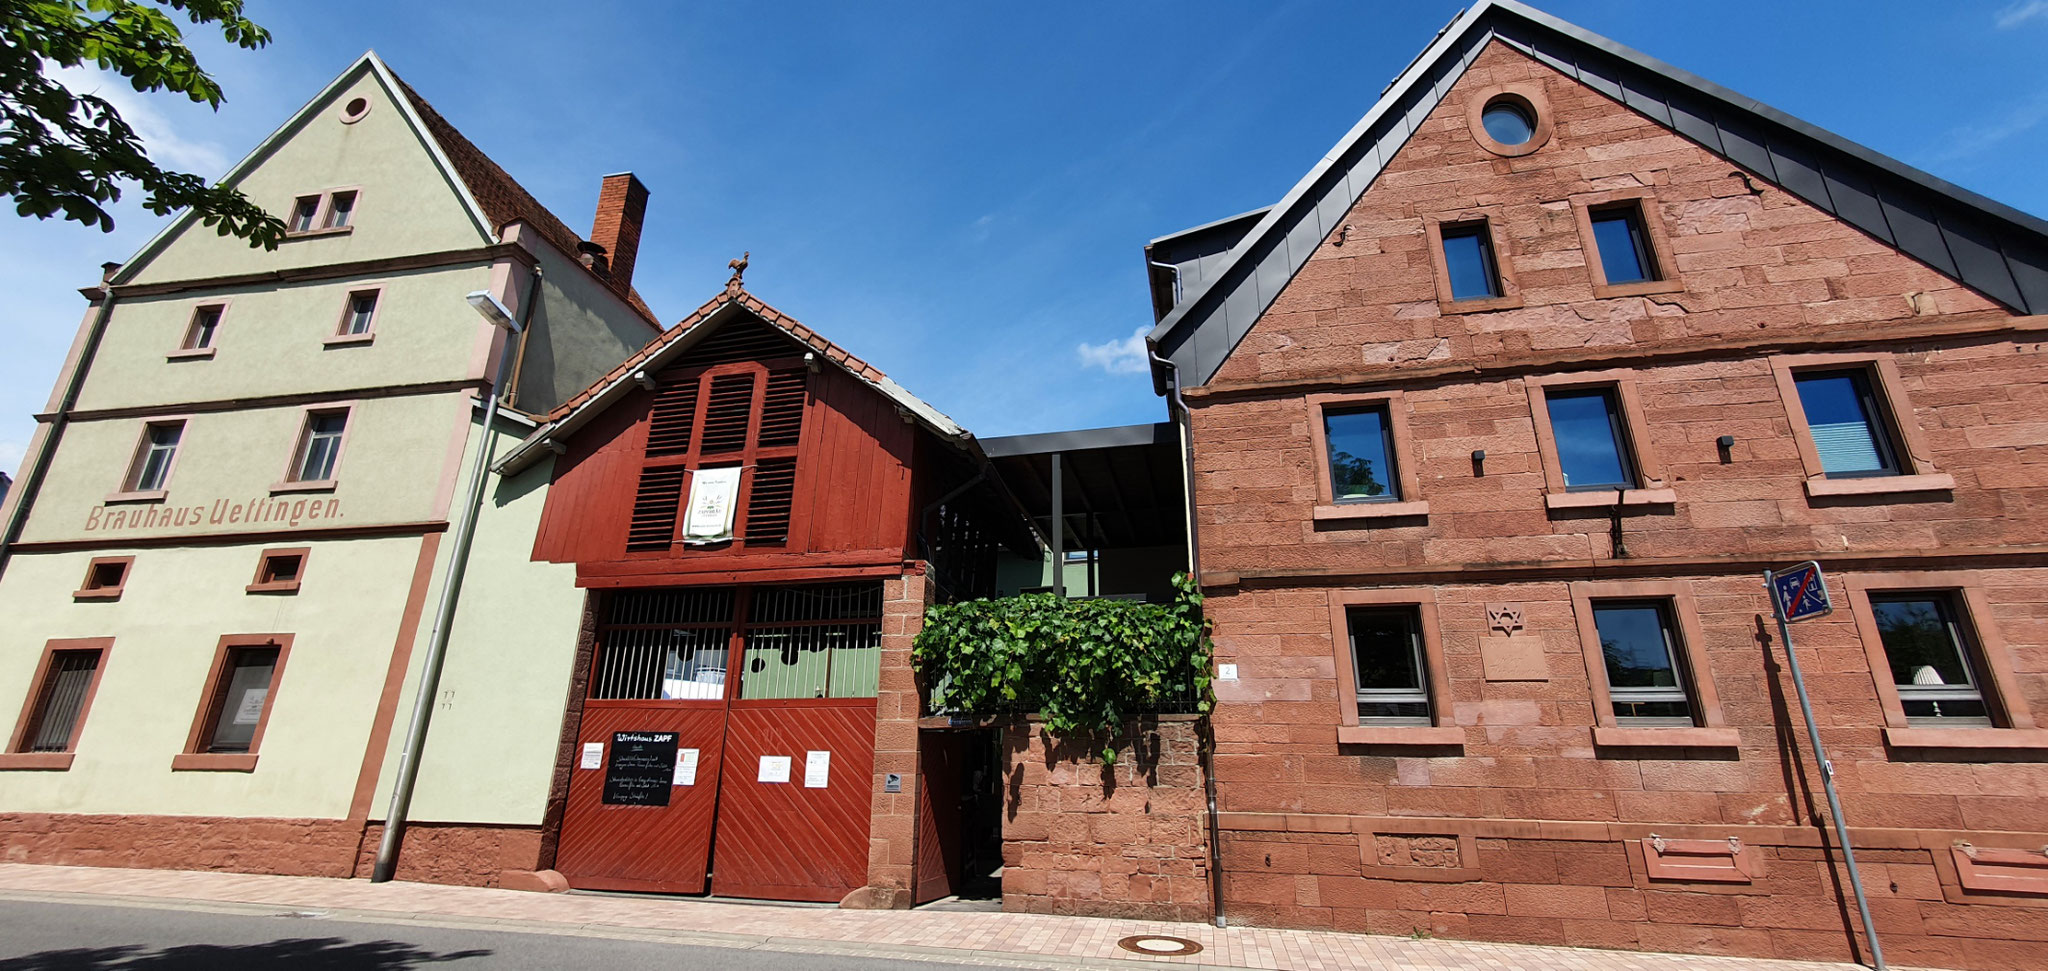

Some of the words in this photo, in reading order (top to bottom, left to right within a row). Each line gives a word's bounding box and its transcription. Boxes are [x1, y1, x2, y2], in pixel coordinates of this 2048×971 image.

[84, 503, 205, 531] Brauhaus
[209, 498, 344, 527] Uettingen.
[1225, 666, 1231, 674] 2
[617, 734, 652, 742] Wirtshaus
